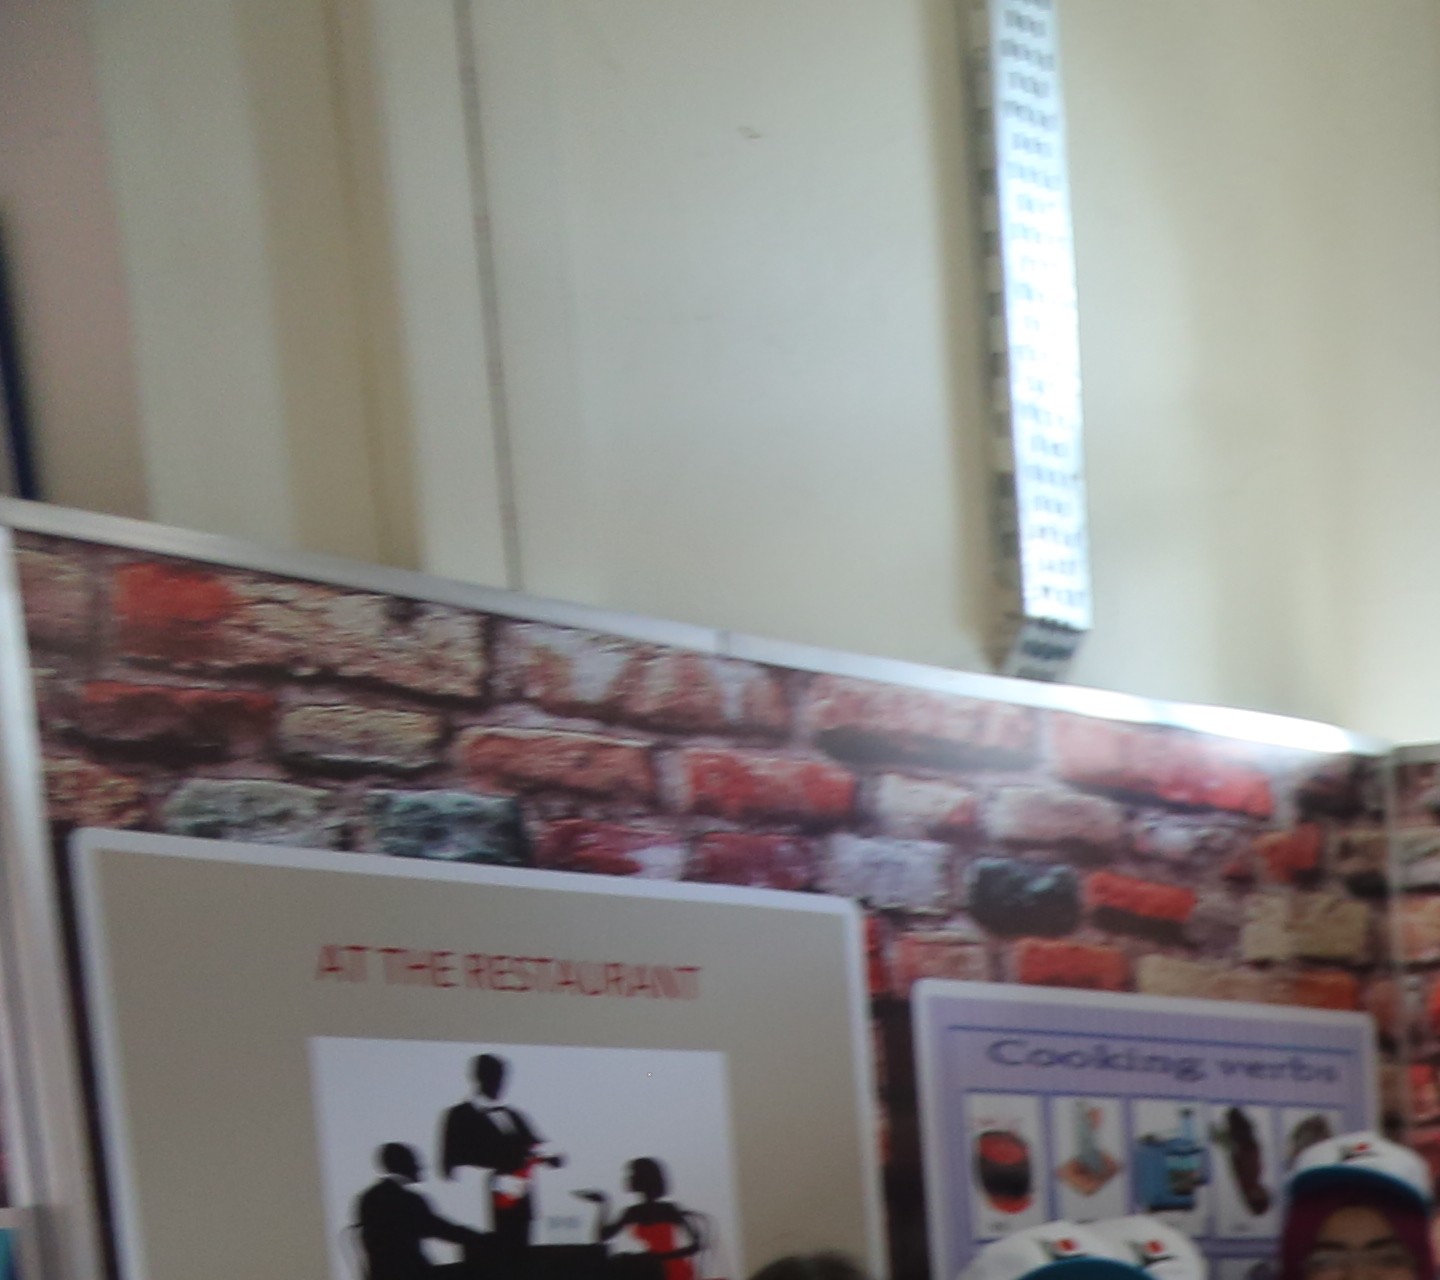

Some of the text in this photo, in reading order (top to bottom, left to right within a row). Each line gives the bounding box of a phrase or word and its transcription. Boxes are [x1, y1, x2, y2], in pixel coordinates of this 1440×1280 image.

[315, 943, 702, 1000] AT THE RESTAURANT
[985, 1038, 1343, 1083] Cooking verbs
